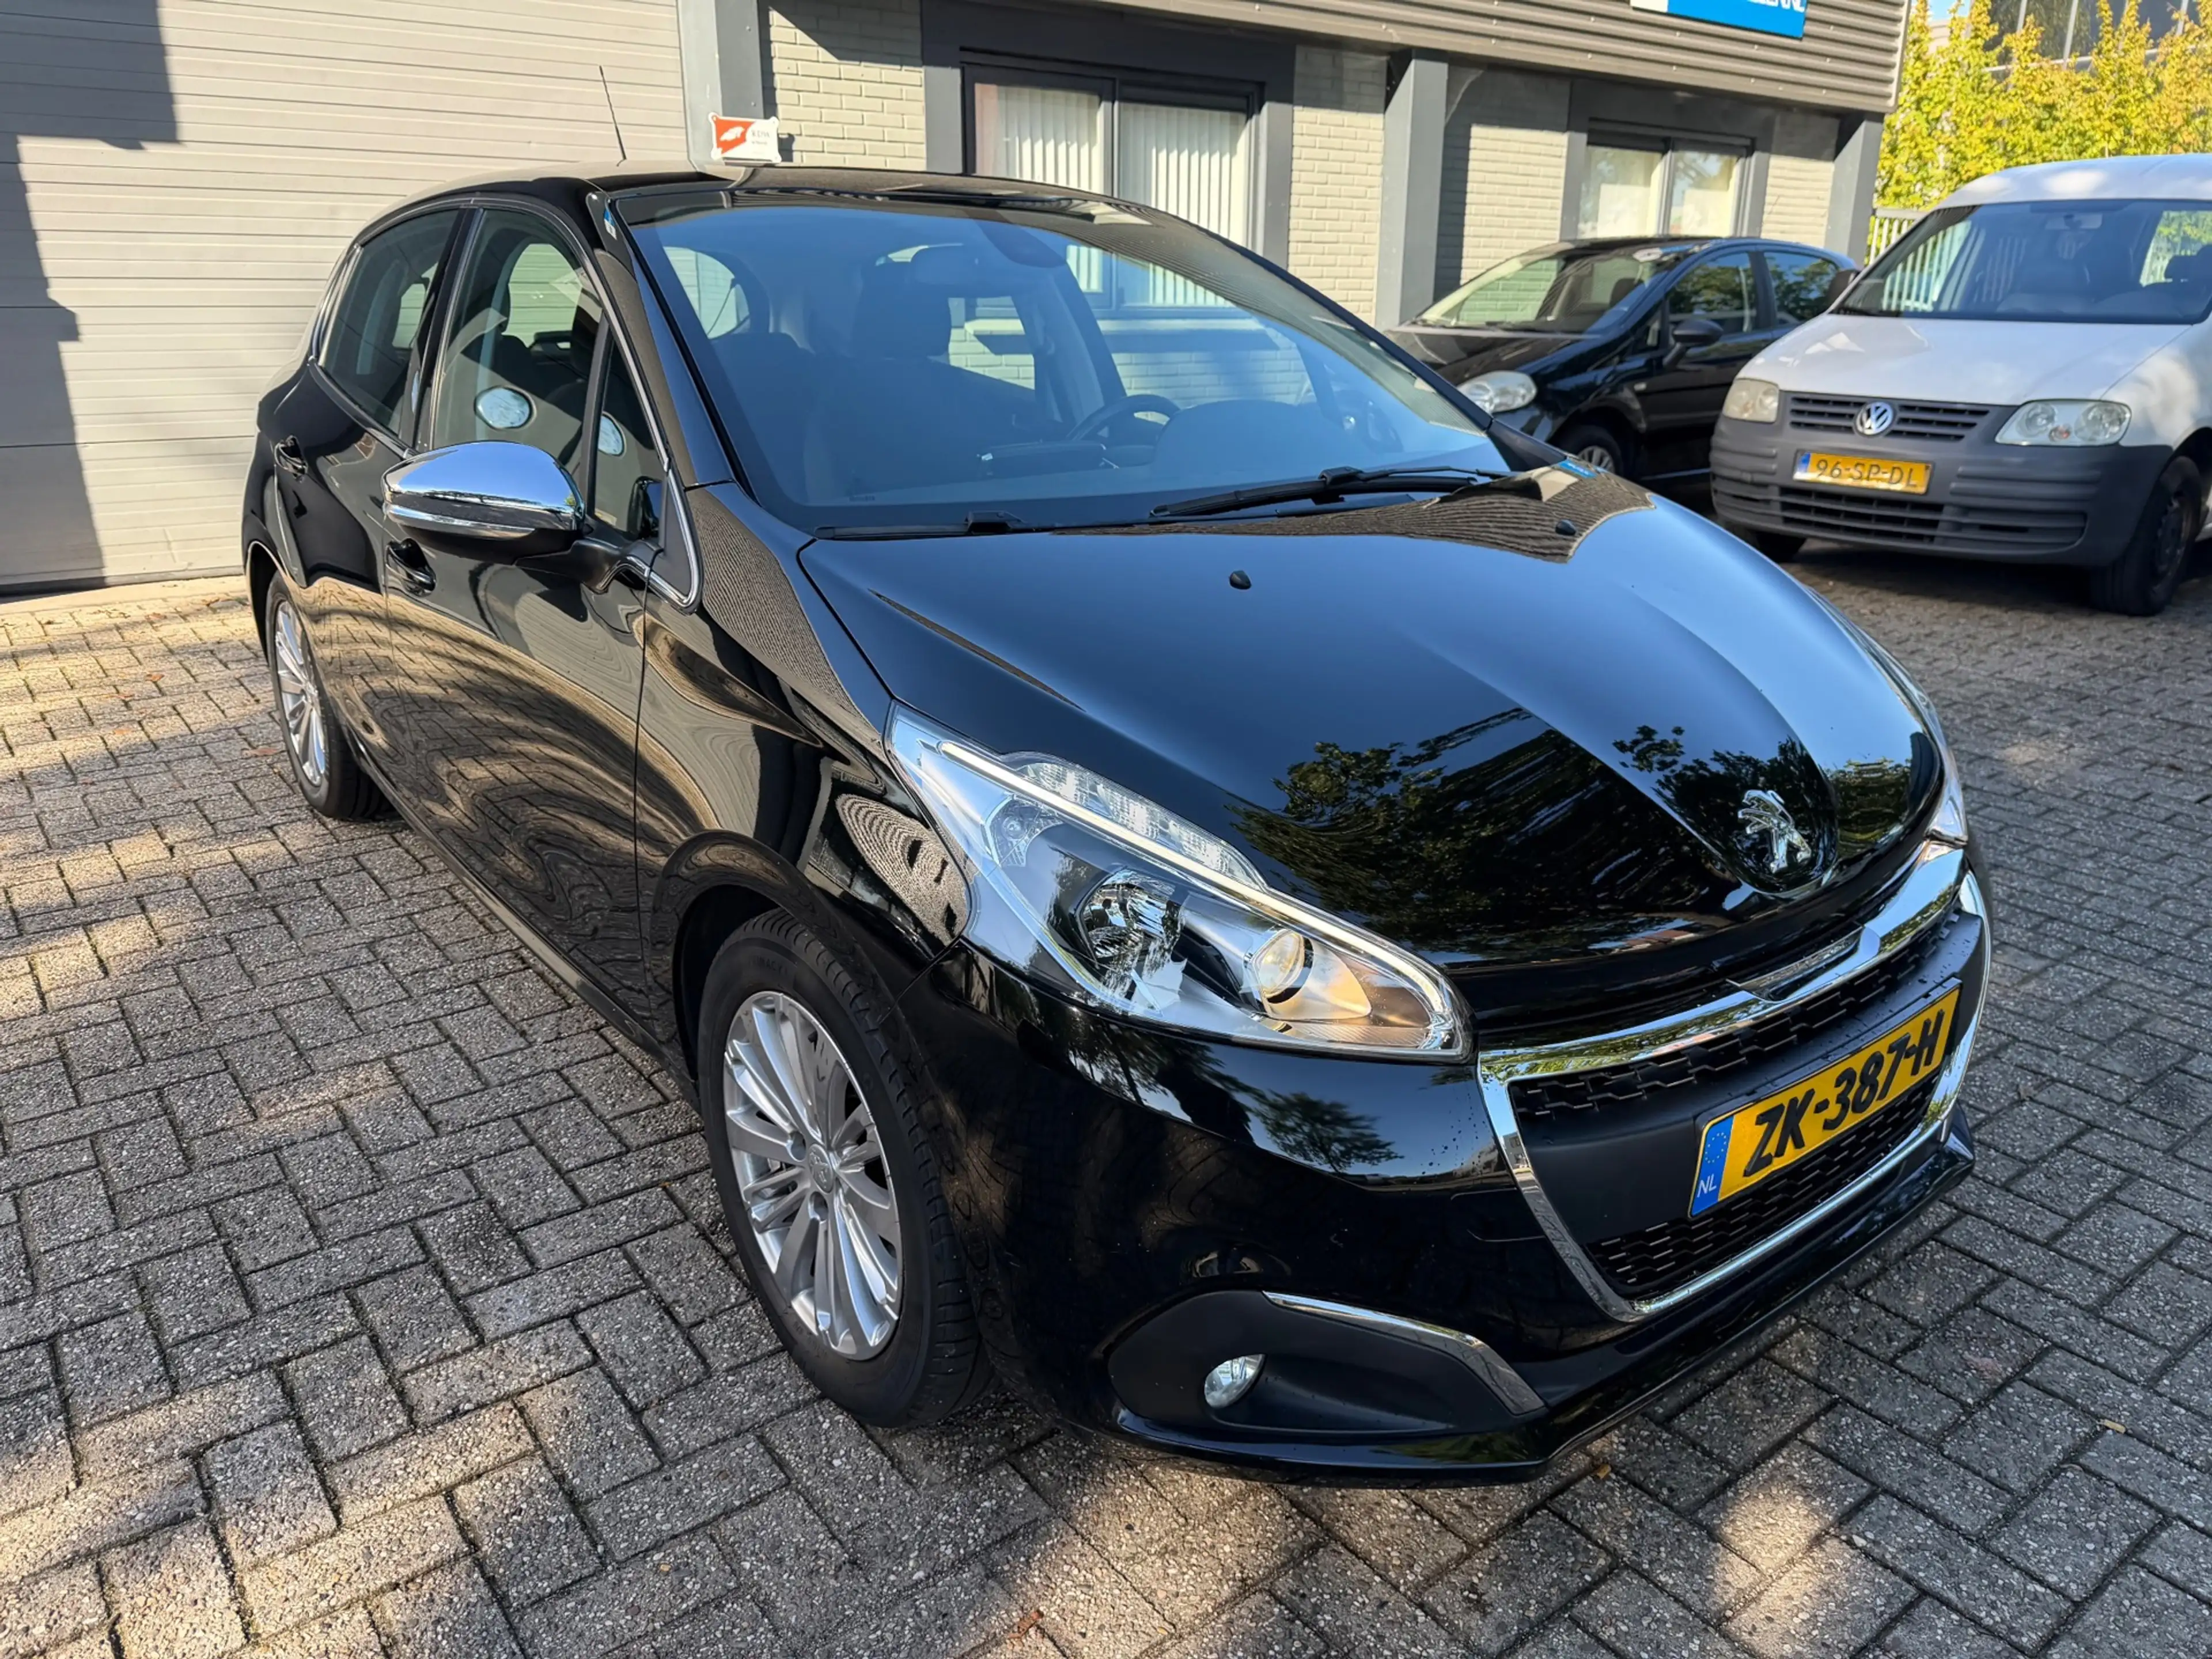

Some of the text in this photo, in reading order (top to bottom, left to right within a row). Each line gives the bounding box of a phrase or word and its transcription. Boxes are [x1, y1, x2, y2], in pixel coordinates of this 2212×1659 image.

[1816, 459, 1917, 487] 96-SP-DL
[1743, 1009, 1945, 1177] ZK-387-H
[1697, 1173, 1717, 1197] NL
